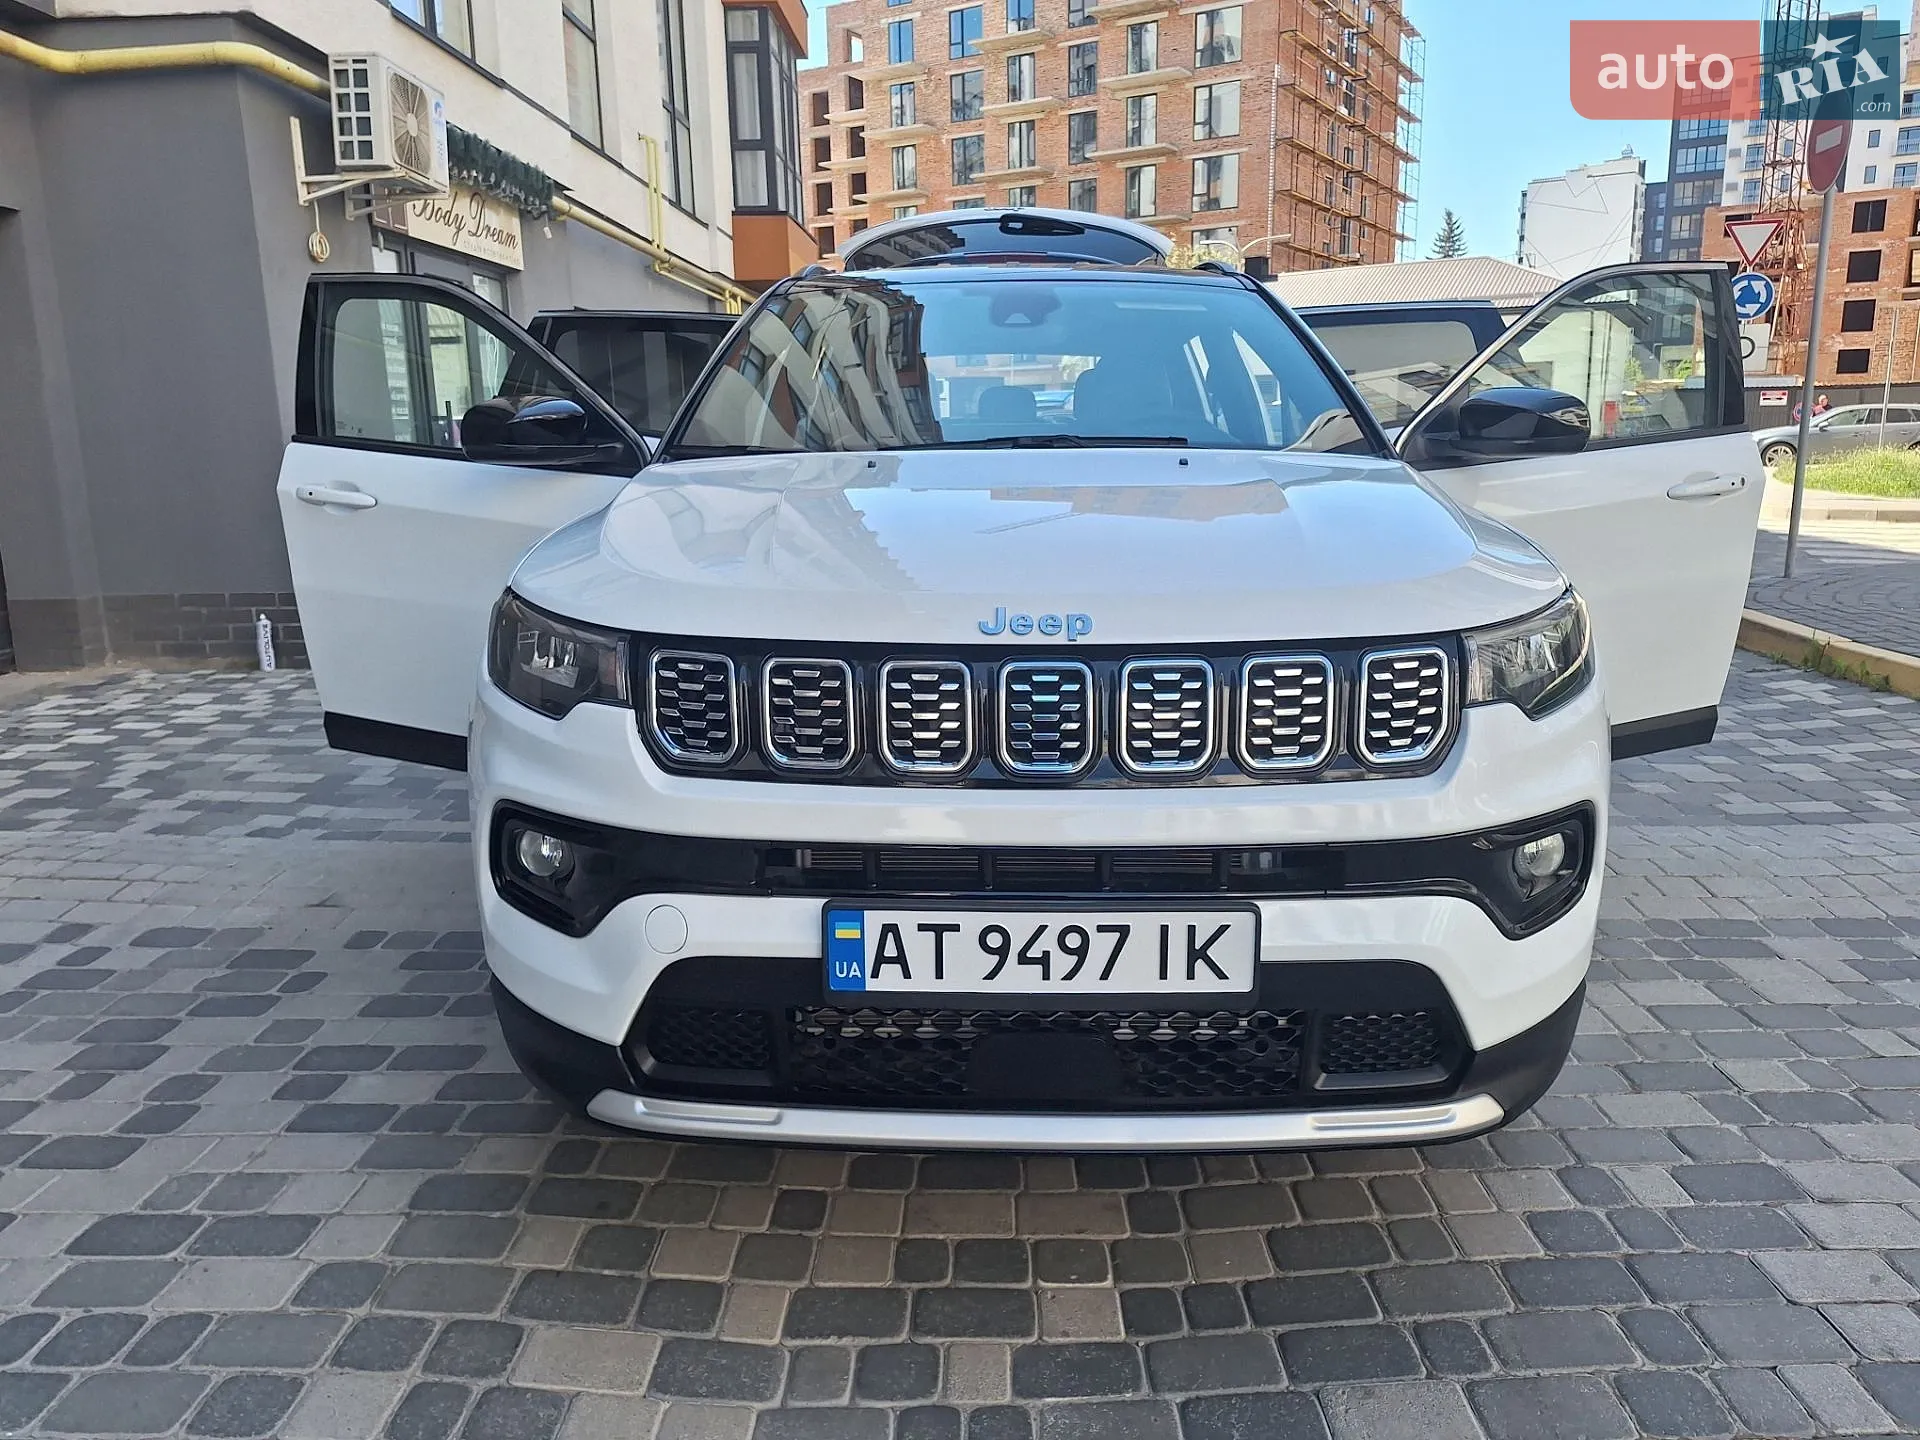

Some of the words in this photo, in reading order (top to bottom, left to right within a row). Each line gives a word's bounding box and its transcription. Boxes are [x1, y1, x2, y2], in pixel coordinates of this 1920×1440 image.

[468, 192, 518, 249] Dream
[979, 607, 1092, 641] Jeep
[835, 961, 861, 978] UA
[870, 923, 961, 980] AT
[978, 924, 1131, 981] 9497
[1159, 924, 1231, 981] IK
